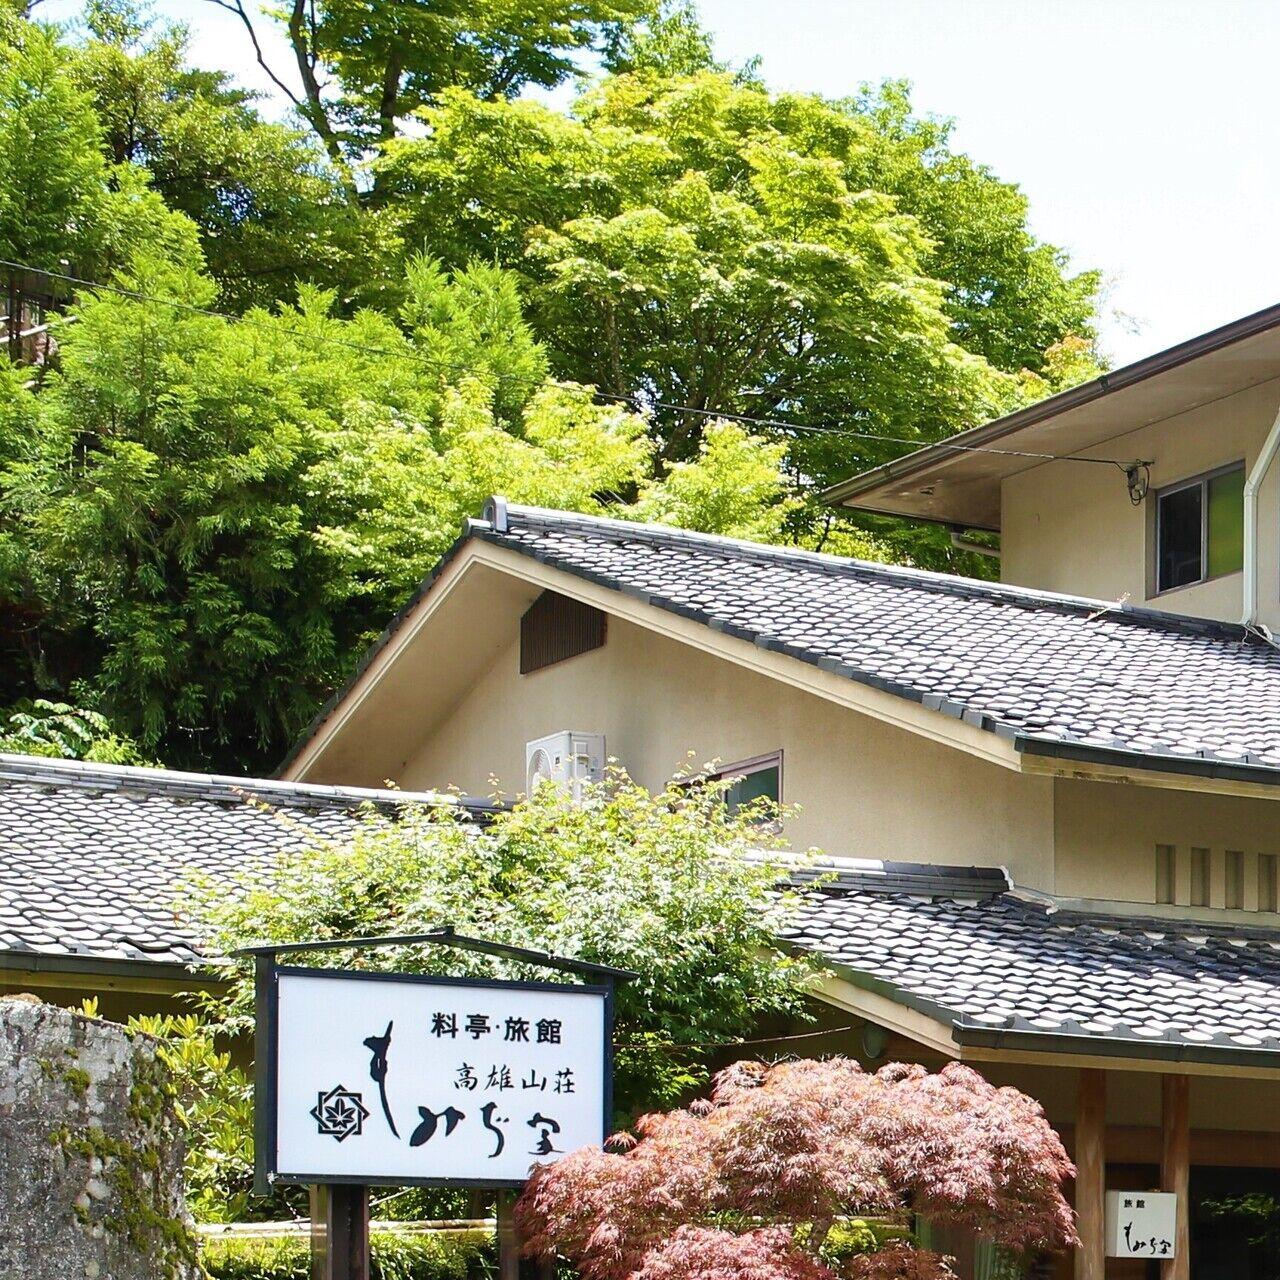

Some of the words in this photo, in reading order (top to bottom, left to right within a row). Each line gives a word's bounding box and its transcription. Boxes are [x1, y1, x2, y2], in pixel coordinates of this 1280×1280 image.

[431, 1012, 563, 1045] 料亭・旅館
[453, 1062, 576, 1095] 高雄山荘
